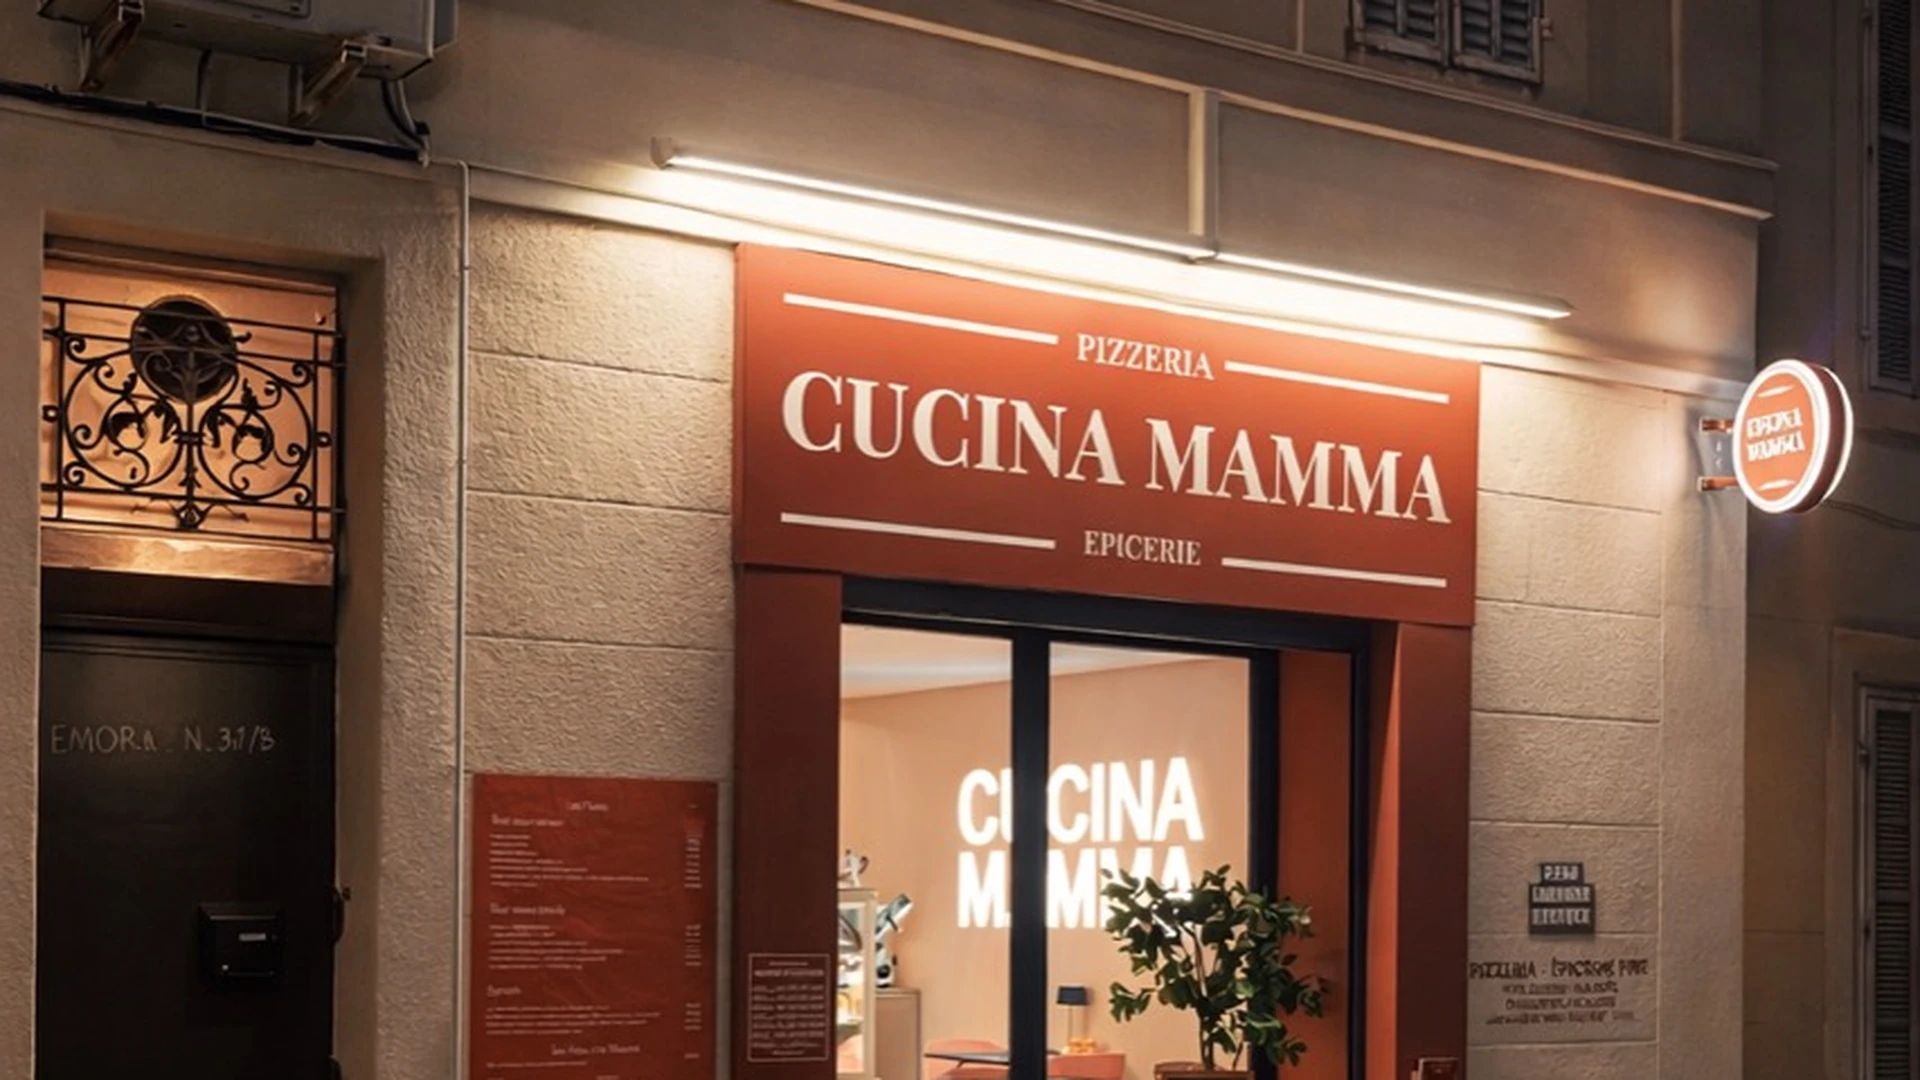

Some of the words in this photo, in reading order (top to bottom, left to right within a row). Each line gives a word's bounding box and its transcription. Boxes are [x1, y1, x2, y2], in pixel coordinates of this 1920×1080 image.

[1077, 333, 1215, 380] PIZZERIA
[780, 370, 1125, 487] CUCINA
[1144, 416, 1452, 524] MAMMA
[1084, 530, 1201, 566] EPICERIE
[957, 845, 1200, 929] MMMA
